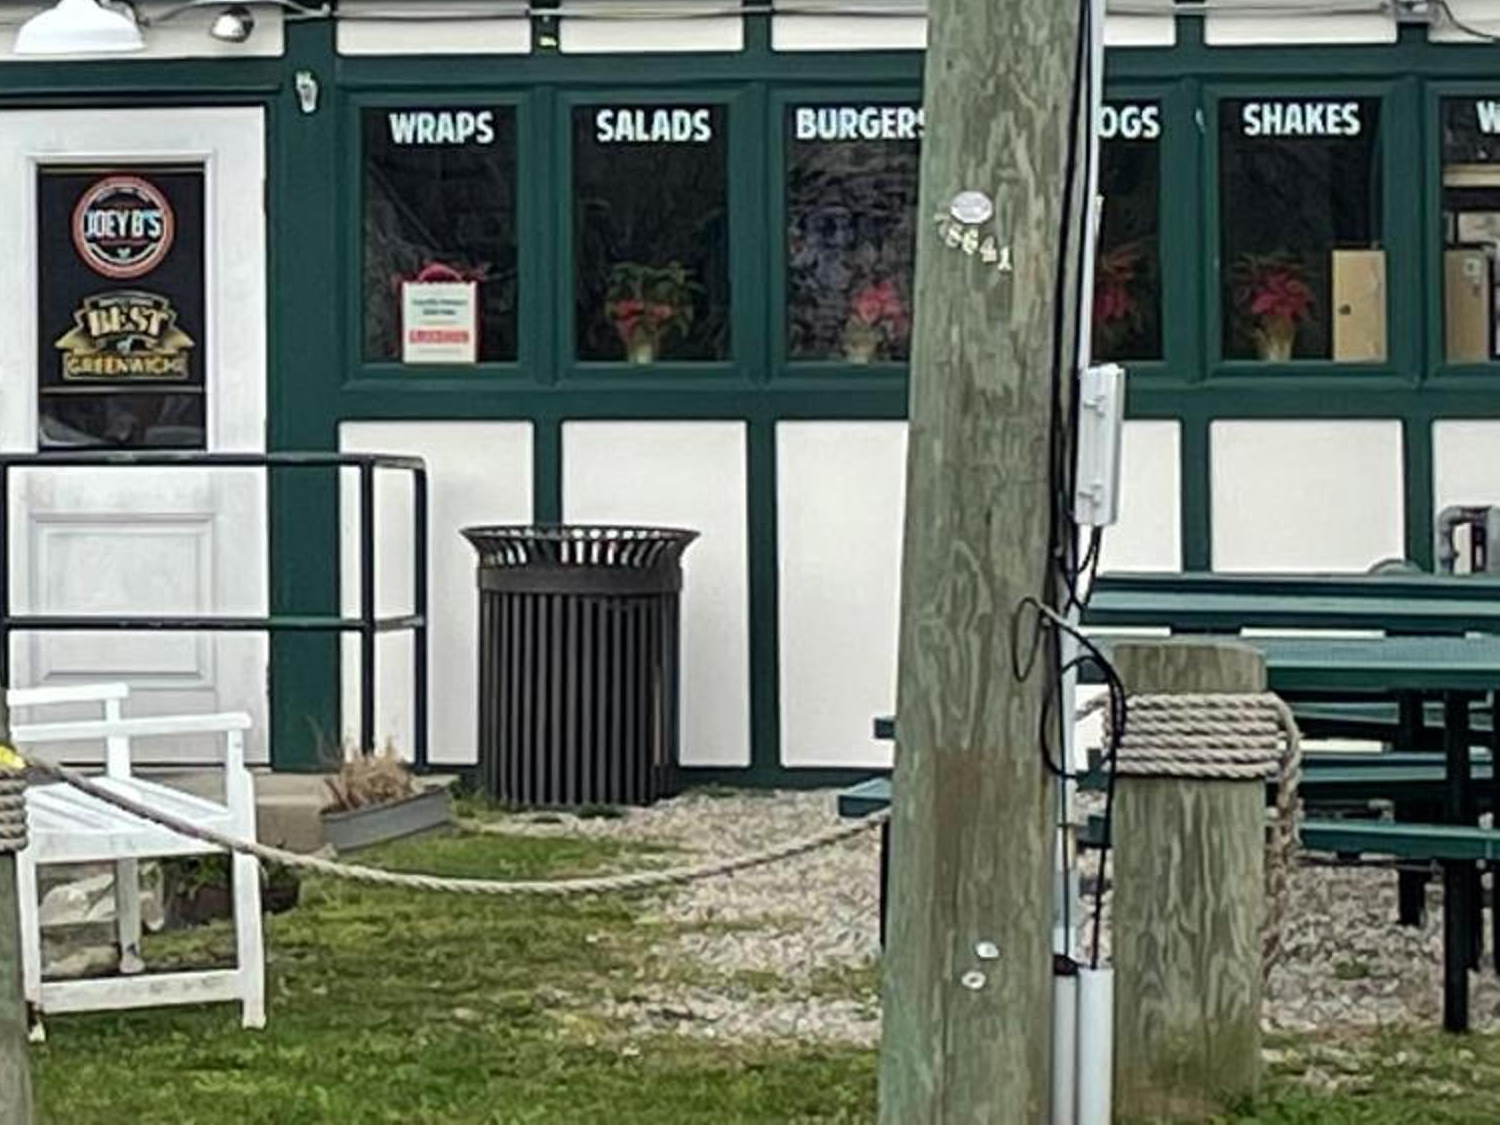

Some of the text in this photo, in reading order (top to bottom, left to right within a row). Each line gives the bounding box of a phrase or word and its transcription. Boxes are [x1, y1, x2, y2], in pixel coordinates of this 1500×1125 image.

[389, 111, 495, 144] WRAPS
[596, 109, 712, 142] SALADS
[1097, 105, 1160, 138] OGS
[1243, 102, 1361, 136] SHAKES
[85, 208, 130, 238] JOEY
[88, 305, 169, 337] BEST
